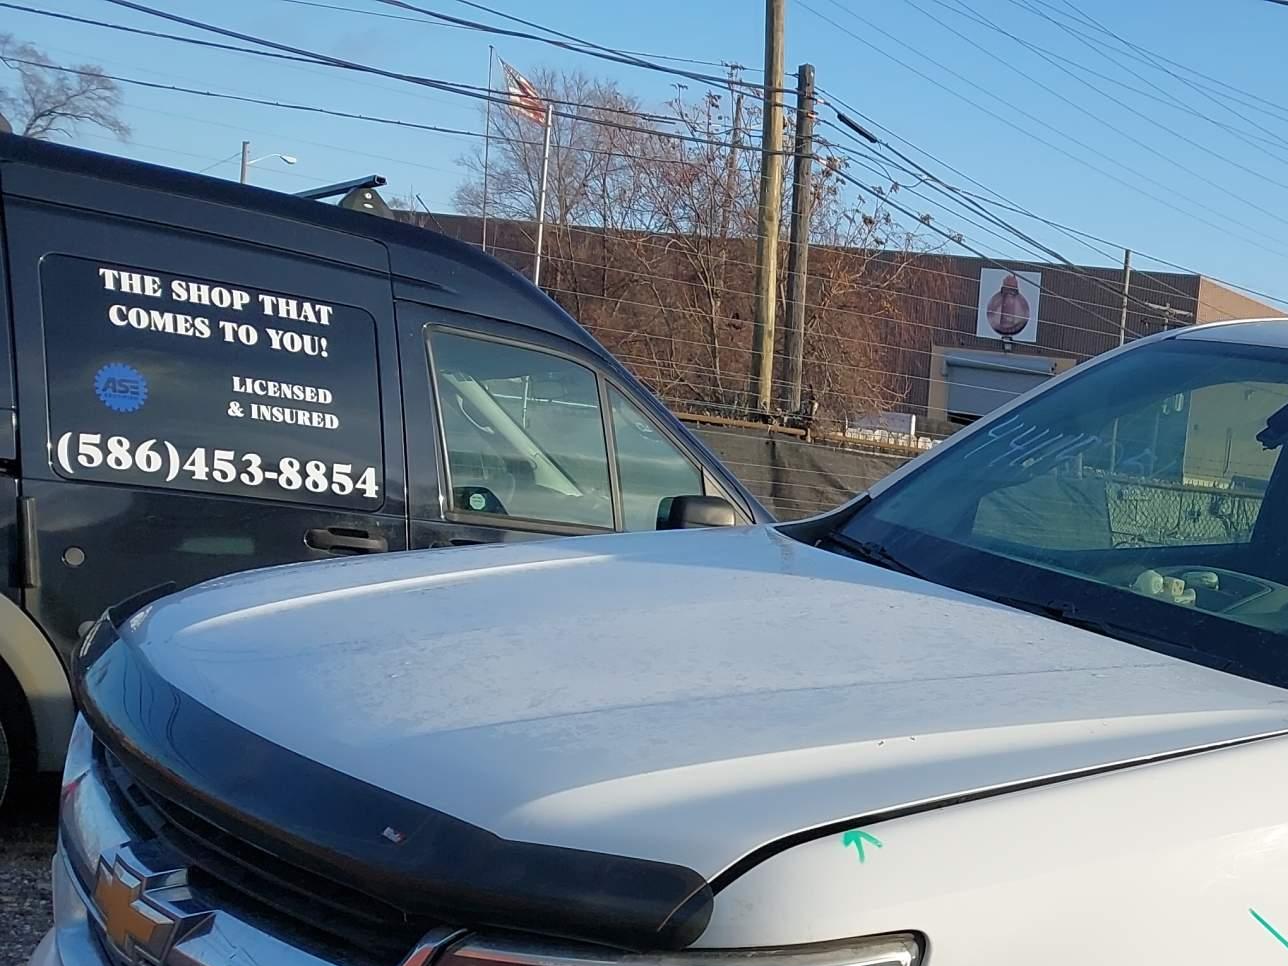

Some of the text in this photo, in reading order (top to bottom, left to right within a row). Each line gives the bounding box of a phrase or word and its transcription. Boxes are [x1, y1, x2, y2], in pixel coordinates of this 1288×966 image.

[99, 268, 333, 326] THE SHOP THAT
[108, 304, 330, 358] COMES TO YOU!
[102, 377, 139, 395] ASE
[232, 376, 333, 404] LICENSED
[227, 401, 340, 430] & INSURED
[57, 432, 379, 499] (586)453-8854
